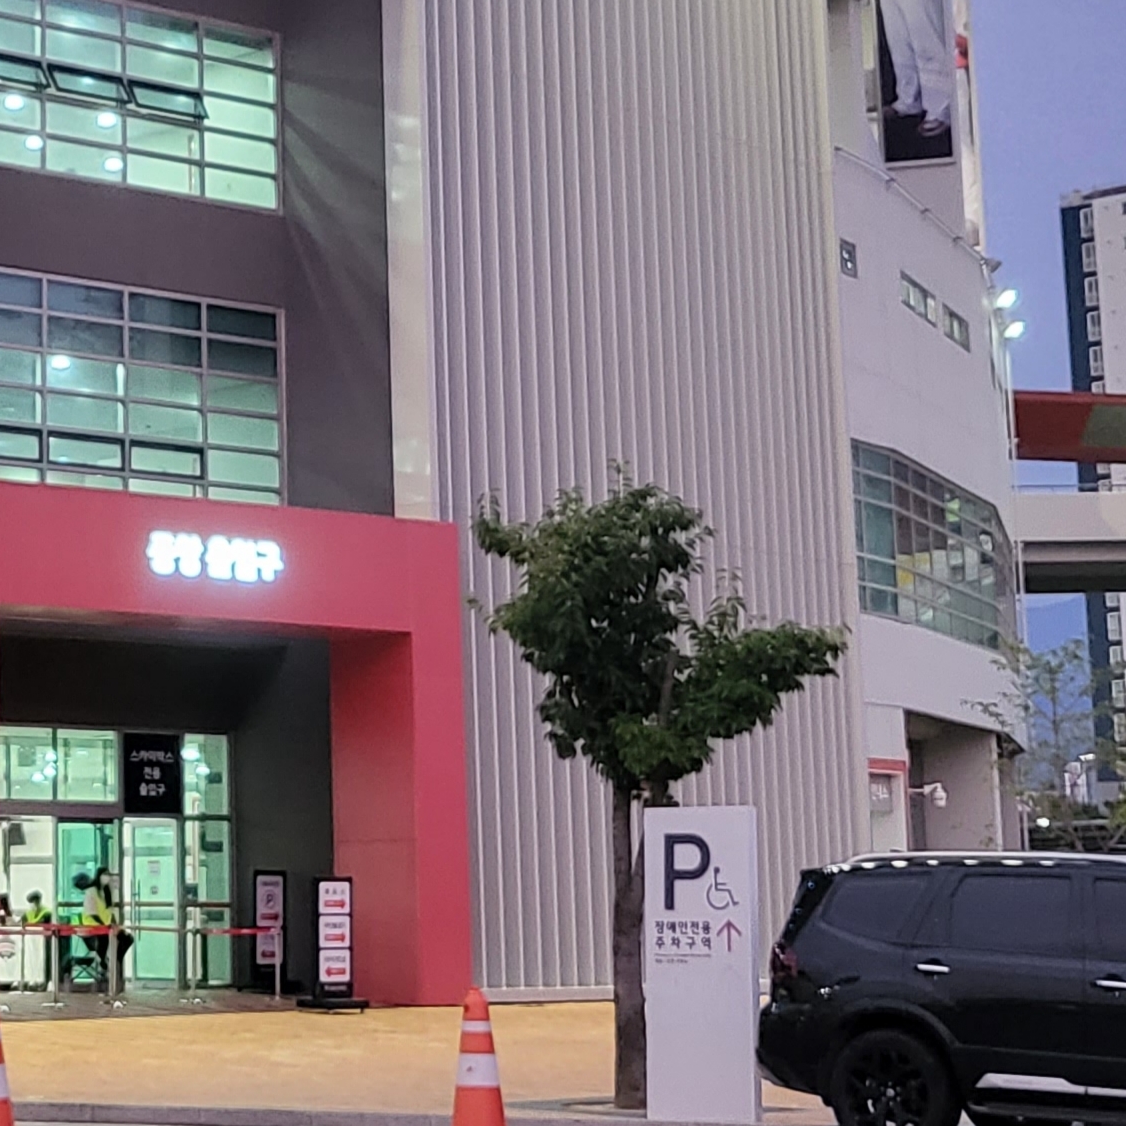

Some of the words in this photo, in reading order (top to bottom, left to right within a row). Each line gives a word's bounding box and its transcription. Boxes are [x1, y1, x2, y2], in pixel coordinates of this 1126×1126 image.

[139, 782, 166, 796] 출입구
[664, 833, 710, 910] P
[654, 920, 711, 935] 장애인전용
[655, 936, 711, 950] 주차구역
